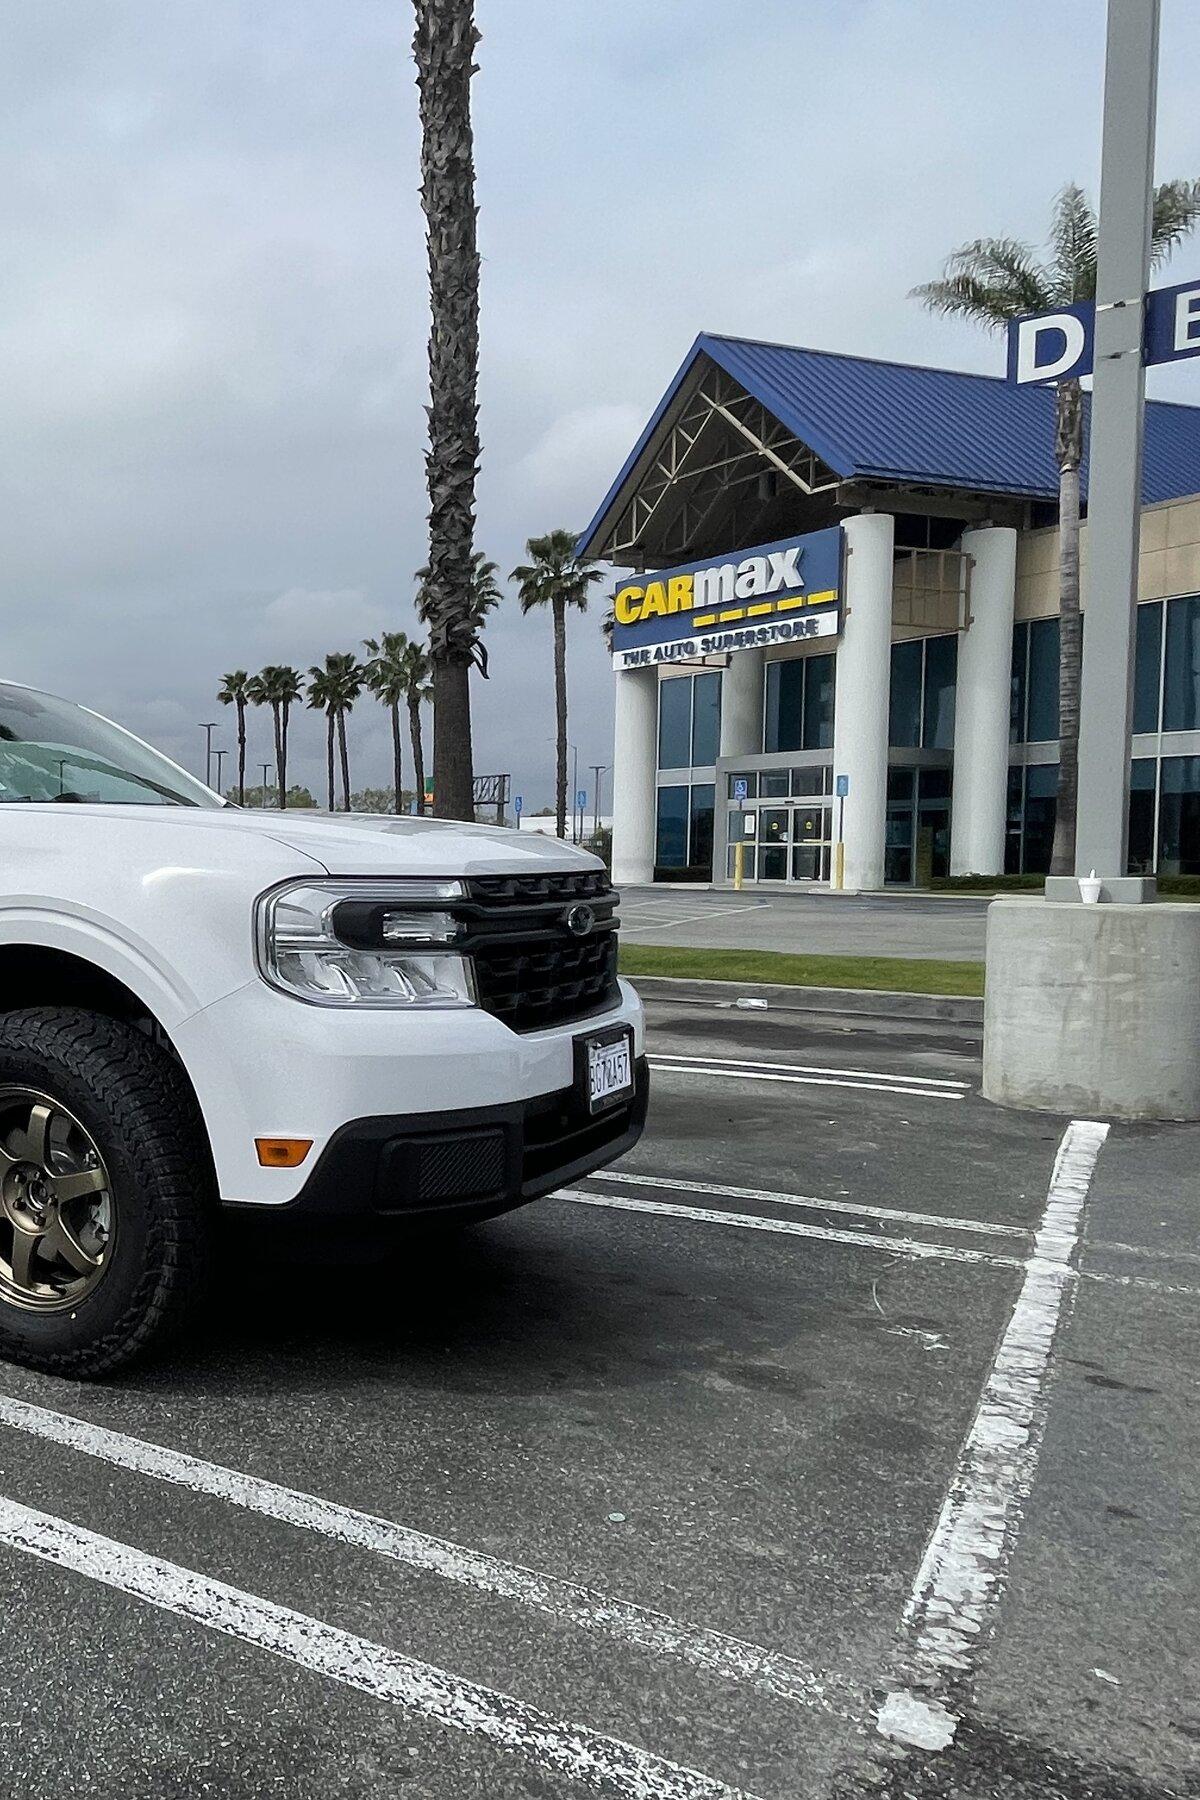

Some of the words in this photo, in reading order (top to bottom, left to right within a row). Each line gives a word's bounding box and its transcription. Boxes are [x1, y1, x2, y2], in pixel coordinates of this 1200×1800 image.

[1016, 313, 1085, 384] D
[621, 649, 651, 666] THE
[653, 639, 697, 661] AUTO
[701, 618, 820, 653] SUPERSTORE
